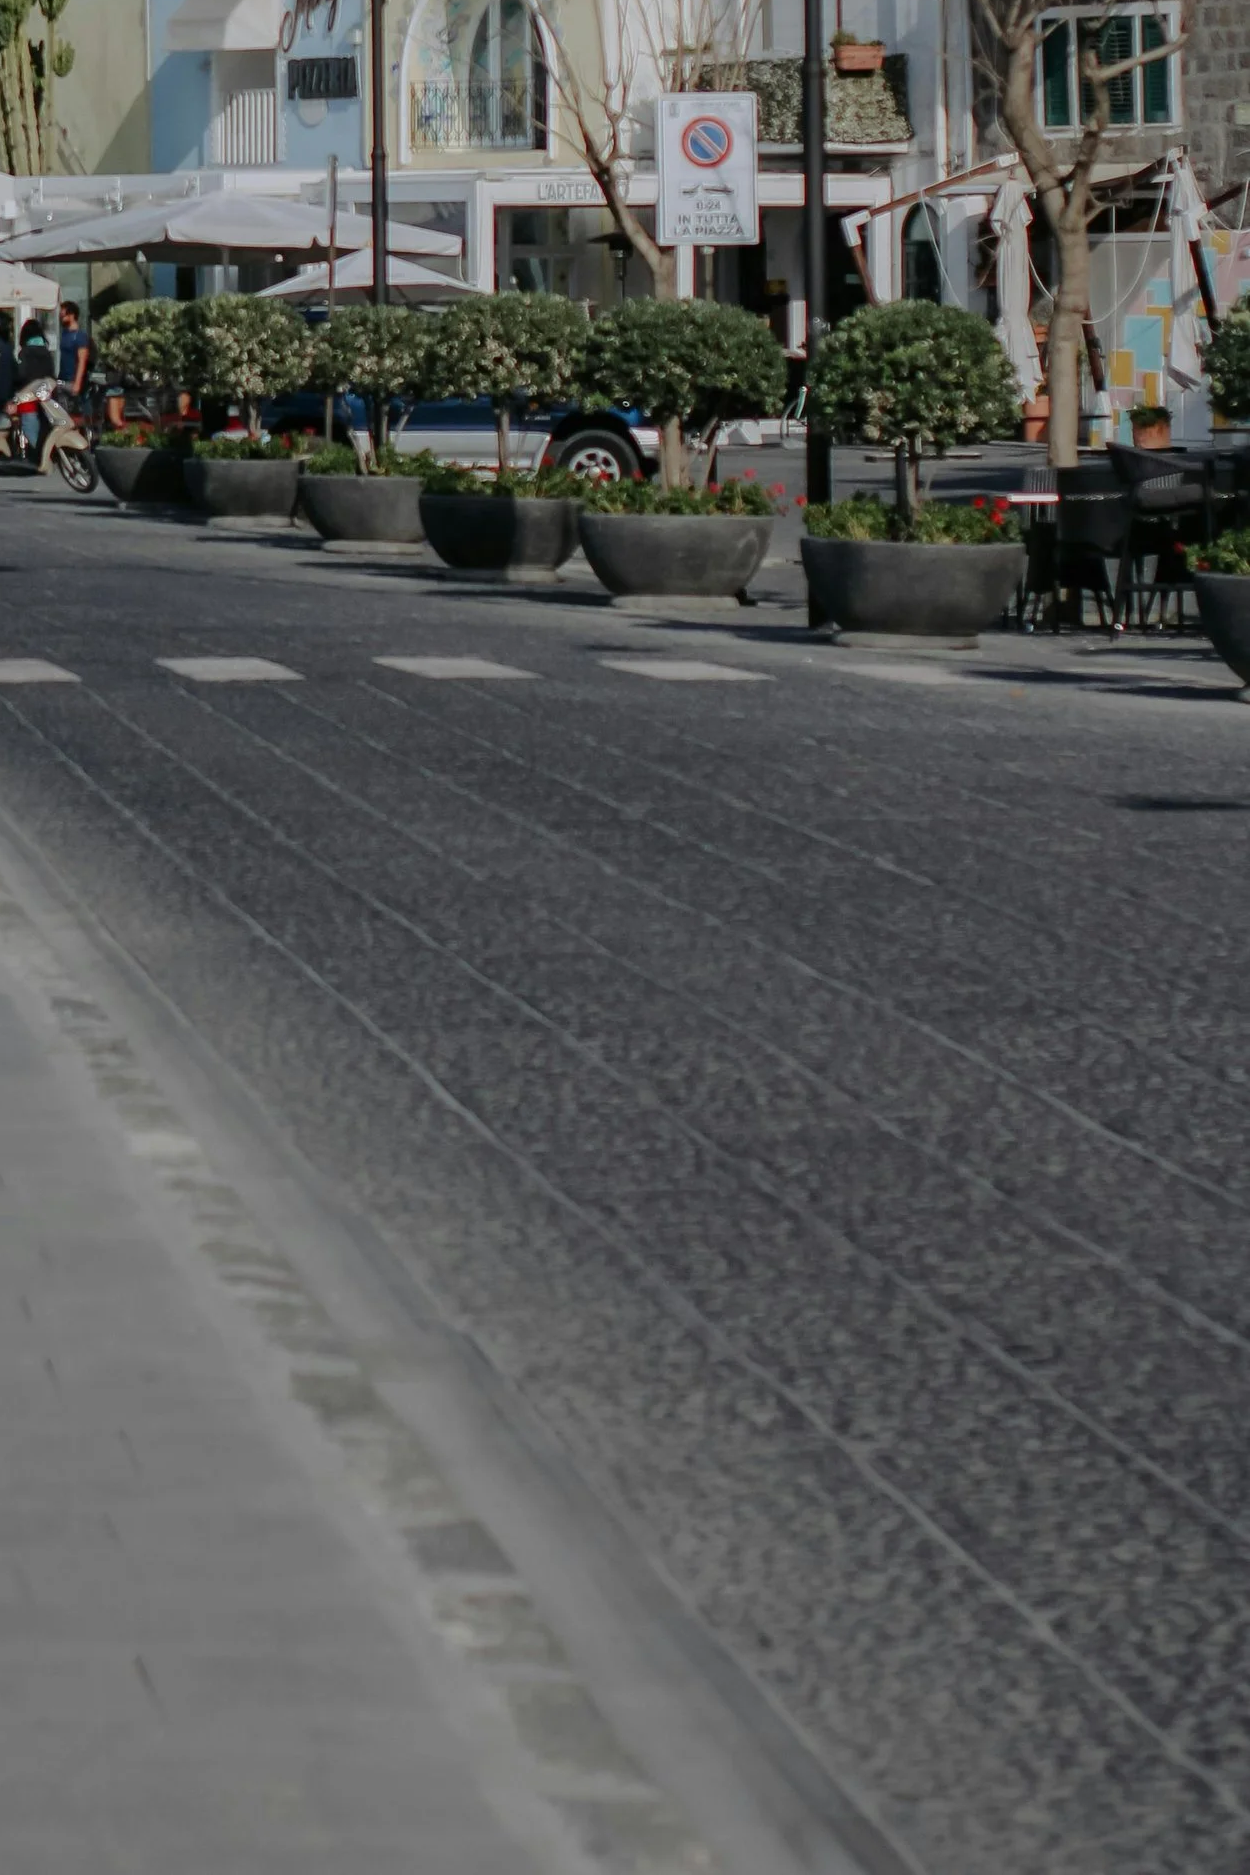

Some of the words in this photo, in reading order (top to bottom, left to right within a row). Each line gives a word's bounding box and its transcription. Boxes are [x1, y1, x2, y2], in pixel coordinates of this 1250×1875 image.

[678, 213, 691, 224] IN
[696, 213, 739, 224] TUTTA
[674, 225, 691, 235] LA
[695, 225, 744, 235] PIAZZA
